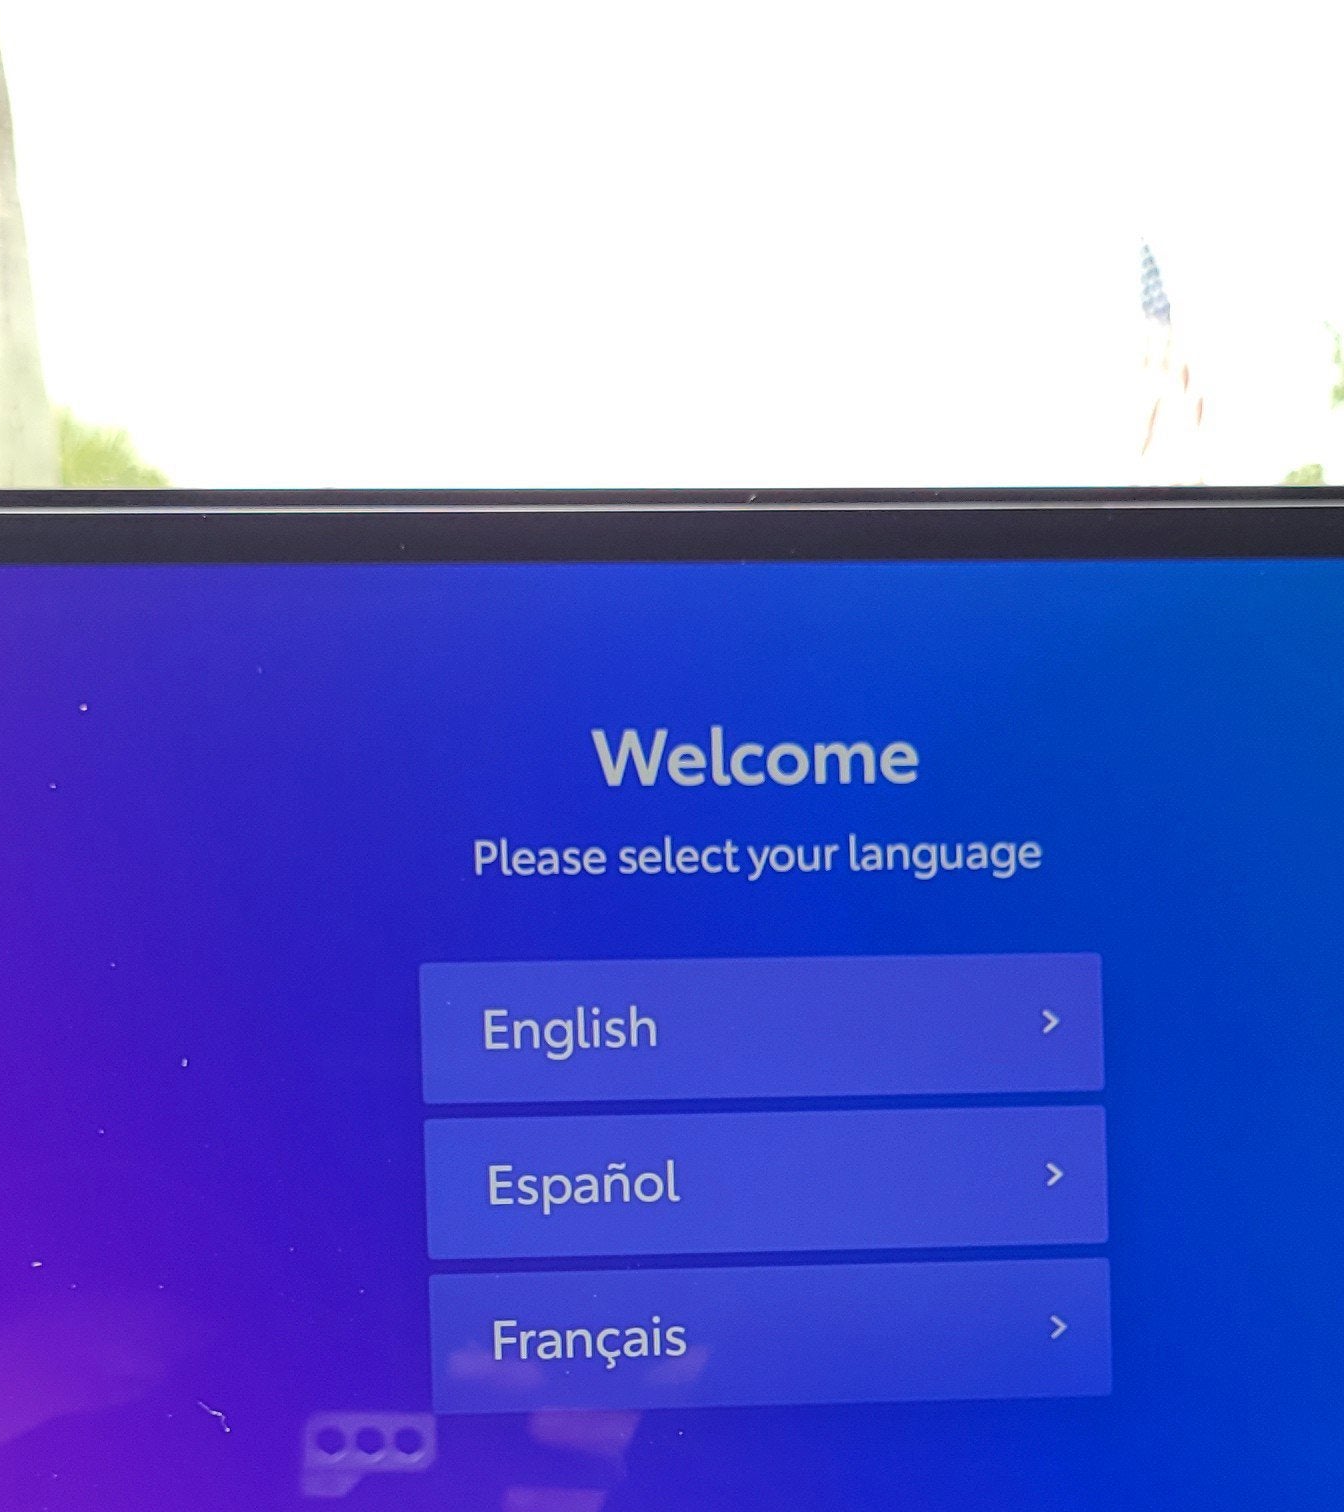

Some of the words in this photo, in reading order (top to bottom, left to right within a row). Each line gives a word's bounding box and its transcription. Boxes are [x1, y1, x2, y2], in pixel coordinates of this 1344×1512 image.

[591, 726, 920, 788] Welcome
[473, 837, 607, 877] Please
[618, 836, 739, 875] select
[747, 841, 839, 881] your
[848, 834, 1043, 880] language
[482, 1006, 658, 1060] English
[487, 1160, 681, 1216] Español
[492, 1315, 688, 1369] Français
